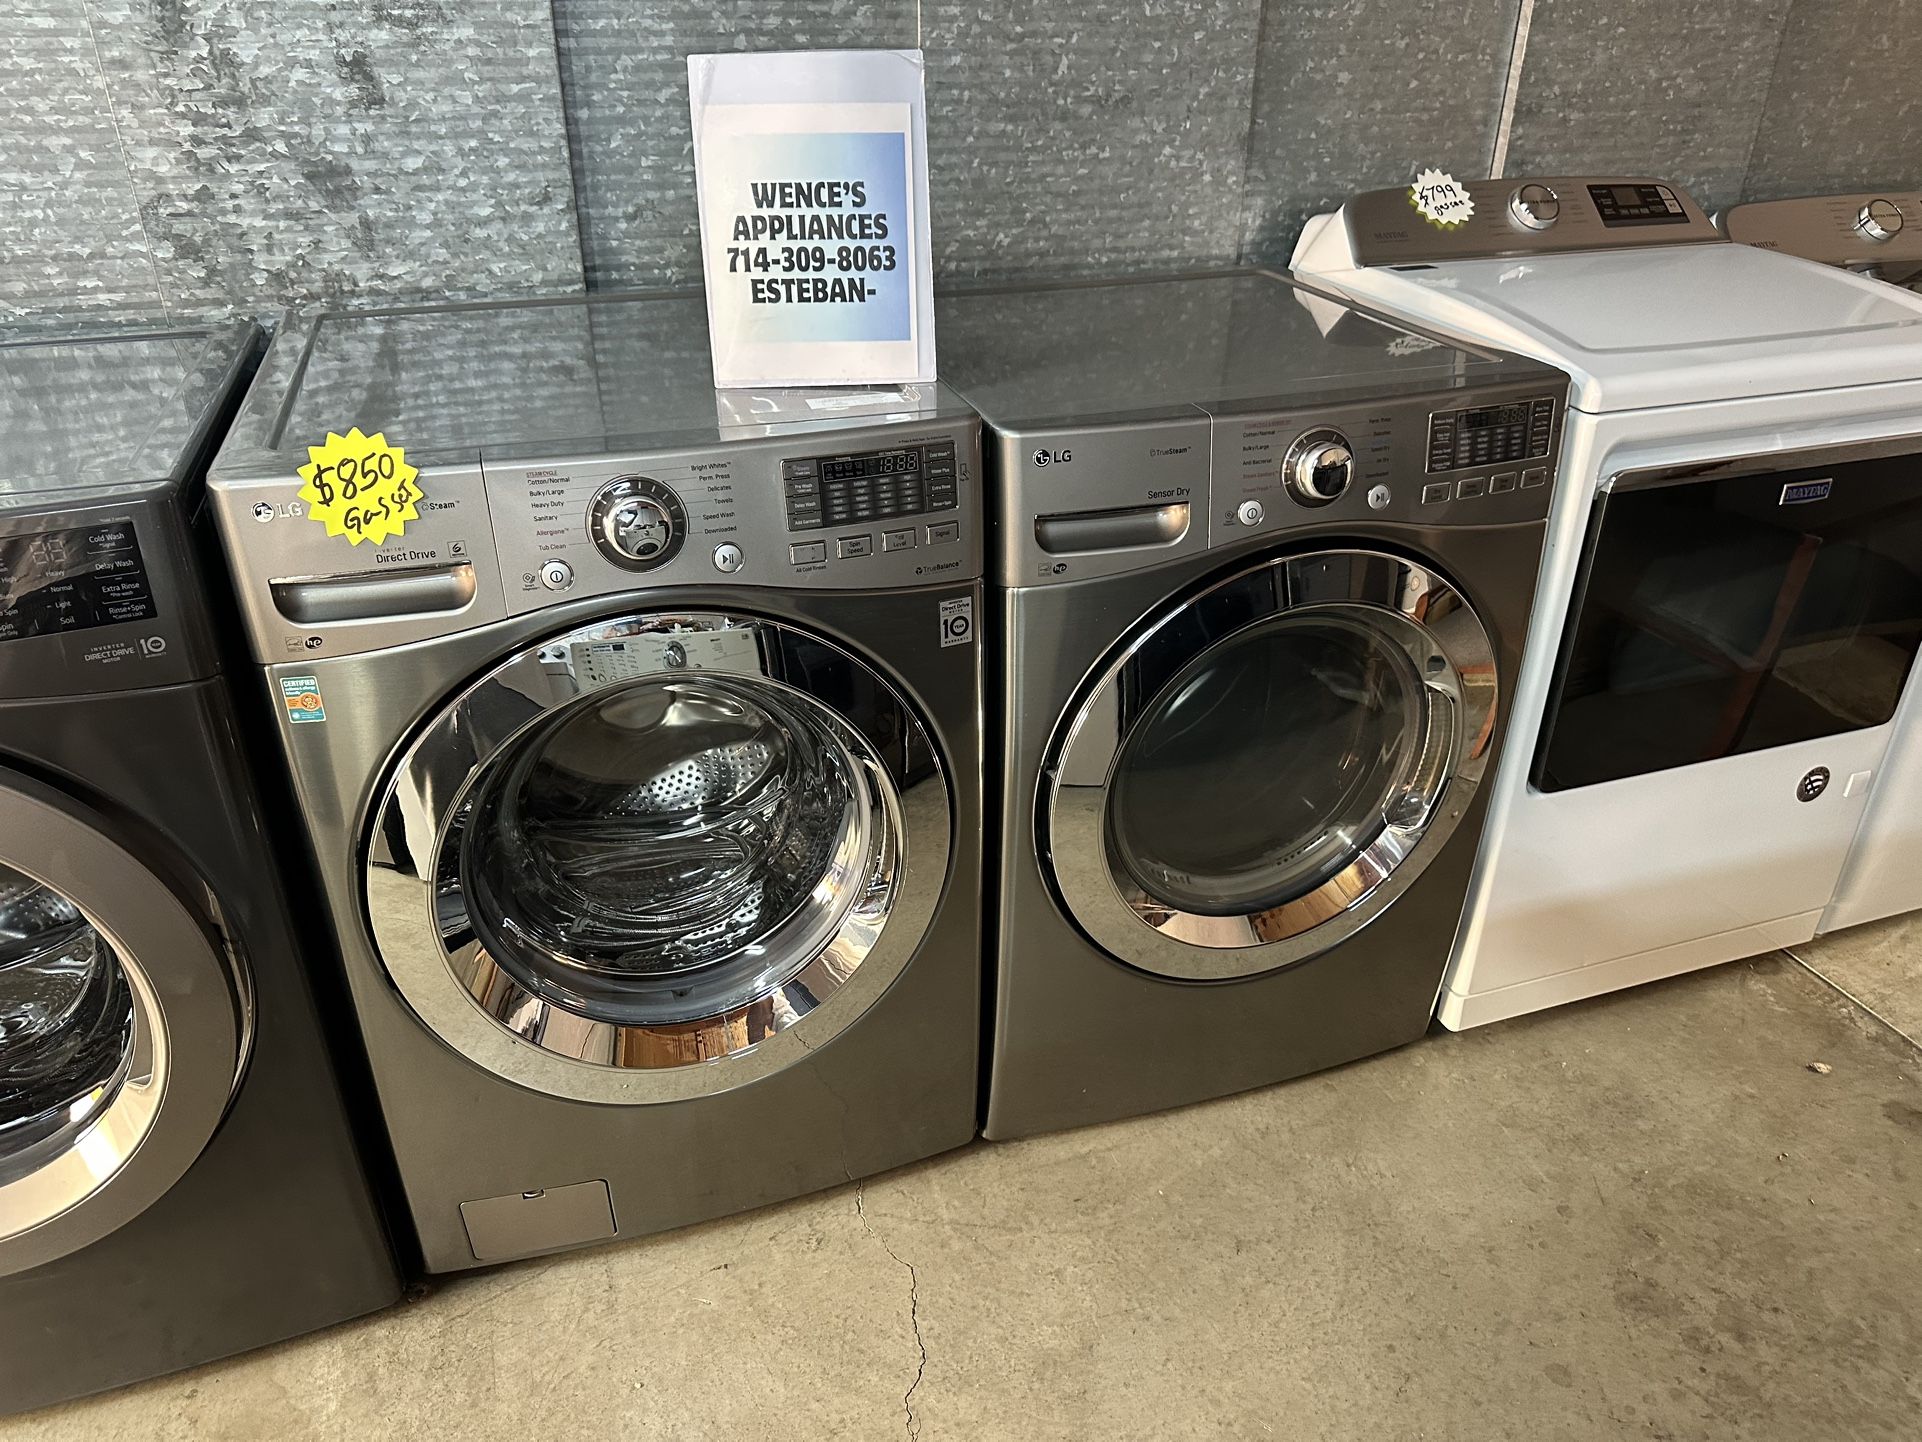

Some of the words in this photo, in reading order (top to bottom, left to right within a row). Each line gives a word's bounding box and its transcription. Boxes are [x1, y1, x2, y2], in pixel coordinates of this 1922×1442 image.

[751, 181, 867, 208] WENCE'S
[1419, 184, 1457, 208] $799
[733, 213, 888, 241] APPLIANCES
[727, 245, 897, 273] 714-309-8063
[750, 277, 877, 304] ESTEBAN-
[1053, 449, 1073, 463] LG
[690, 464, 708, 473] Bright
[312, 452, 395, 507] $850
[527, 476, 571, 485] Cotton/Normal
[715, 472, 731, 480] Press
[707, 484, 732, 492] Delicates
[1147, 488, 1175, 500] Sensor
[1176, 486, 1191, 498] Dry
[1786, 485, 1828, 500] MAYTAG
[529, 489, 565, 498] Bulky/Large
[531, 502, 550, 510] Heavy
[550, 500, 565, 509] Duty
[714, 497, 734, 505] Towels
[277, 503, 303, 518] LG
[533, 514, 558, 523] Sanitary
[703, 513, 719, 521] Speed
[719, 511, 736, 519] Wash
[704, 525, 738, 535] Downloaded
[935, 529, 950, 539] Signal
[88, 534, 105, 544] Cold
[105, 532, 125, 542] Wash
[849, 541, 860, 549] Spin
[847, 547, 864, 555] Speed
[375, 550, 407, 564] Direct
[408, 549, 437, 561] Drive
[95, 562, 114, 571] Delay
[114, 558, 134, 569] Wash
[50, 583, 74, 593] Normal
[101, 584, 120, 593] Extra
[120, 582, 140, 591] Rinse
[55, 601, 72, 609] Light
[108, 603, 146, 615] Rinse+Spin
[4, 608, 19, 617] Spin
[60, 616, 75, 625] Soil
[943, 615, 970, 640] 10
[90, 642, 125, 652] INVERTER
[140, 636, 166, 655] 10
[84, 650, 112, 662] DIRECT
[112, 646, 136, 657] DRIVE
[283, 679, 316, 687] CERTIFIED
